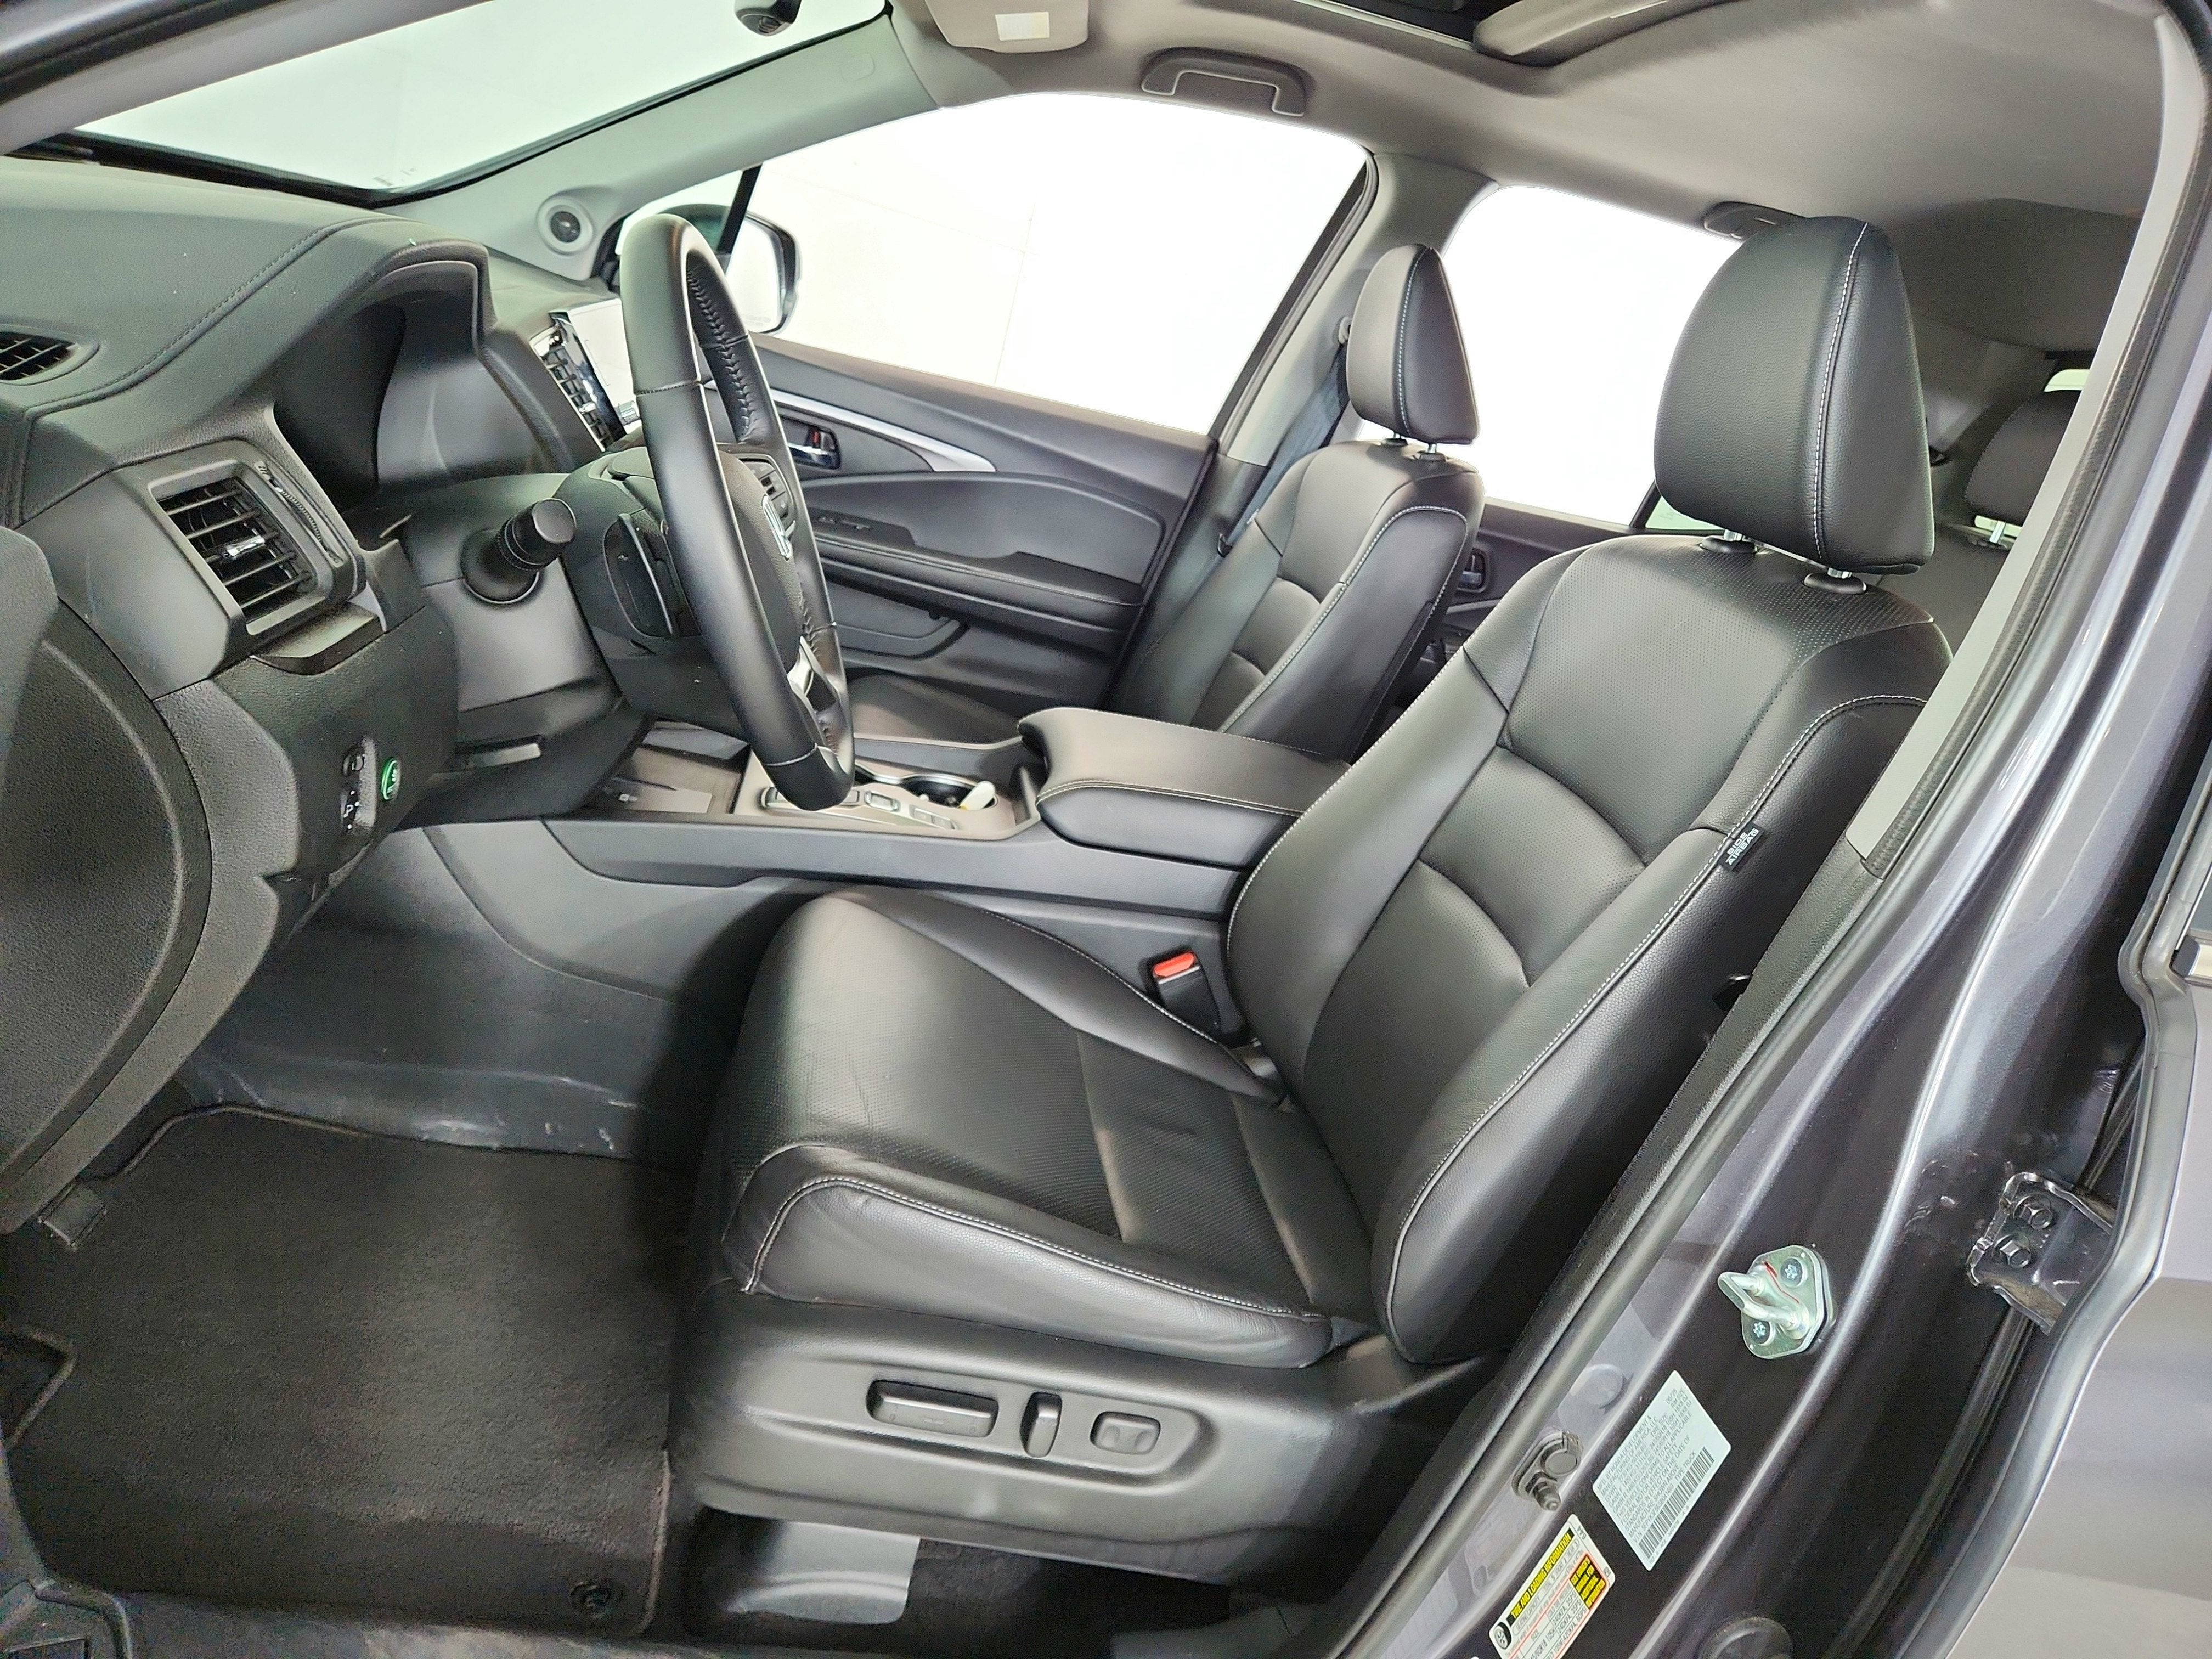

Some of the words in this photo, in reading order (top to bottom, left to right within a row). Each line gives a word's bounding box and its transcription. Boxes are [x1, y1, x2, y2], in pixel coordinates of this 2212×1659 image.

[1727, 832, 1748, 855] SIDE
[1728, 829, 1759, 865] AIRBAG
[1670, 1397, 1678, 1409] RIM
[1676, 1387, 1685, 1400] SIZE
[1650, 1424, 1660, 1437] TIRE
[1658, 1412, 1668, 1426] SIZE
[1600, 1454, 1630, 1497] MANUFACTURING
[1628, 1448, 1634, 1458] OF
[1649, 1415, 1657, 1427] LLC
[1605, 1470, 1612, 1480] BY
[1610, 1452, 1624, 1473] HONDA
[1622, 1418, 1648, 1456] DEVELOPMENT
[1683, 1449, 1696, 1470] TRUCK
[1616, 1505, 1626, 1520] THIS
[1624, 1485, 1640, 1509] VEHICLE
[1638, 1457, 1660, 1488] CONFORMS
[1658, 1449, 1665, 1459] TO
[1663, 1439, 1672, 1452] ALL
[1669, 1409, 1692, 1442] APPLICABLE
[1604, 1484, 1617, 1503] GVWR
[1620, 1501, 1637, 1526] FEDERAL
[1635, 1482, 1650, 1504] MOTOR
[1647, 1460, 1664, 1486] VEHICLE
[1662, 1441, 1678, 1464] SAFETY
[1624, 1499, 1646, 1532] STANDARDS
[1644, 1493, 1650, 1503] IN
[1647, 1475, 1663, 1497] EFFECT
[1661, 1466, 1669, 1477] ON
[1667, 1455, 1676, 1469] THE
[1674, 1442, 1685, 1459] DATE
[1683, 1434, 1691, 1445] OF
[1608, 1490, 1621, 1509] GAWR
[1612, 1496, 1625, 1515] GAWR
[1628, 1498, 1655, 1538] MANUFACTURE
[1652, 1479, 1668, 1502] SHOWN
[1665, 1462, 1679, 1483] ABOVE
[1510, 1602, 1523, 1620] TIRE
[1519, 1590, 1531, 1608] AND
[1527, 1567, 1547, 1596] LOADING
[1543, 1531, 1572, 1573] INFORMATION
[1570, 1573, 1579, 1585] SEE
[1515, 1612, 1528, 1631] SEATING
[1525, 1594, 1541, 1616] CAPACITY
[1530, 1628, 1539, 1641] SIZE
